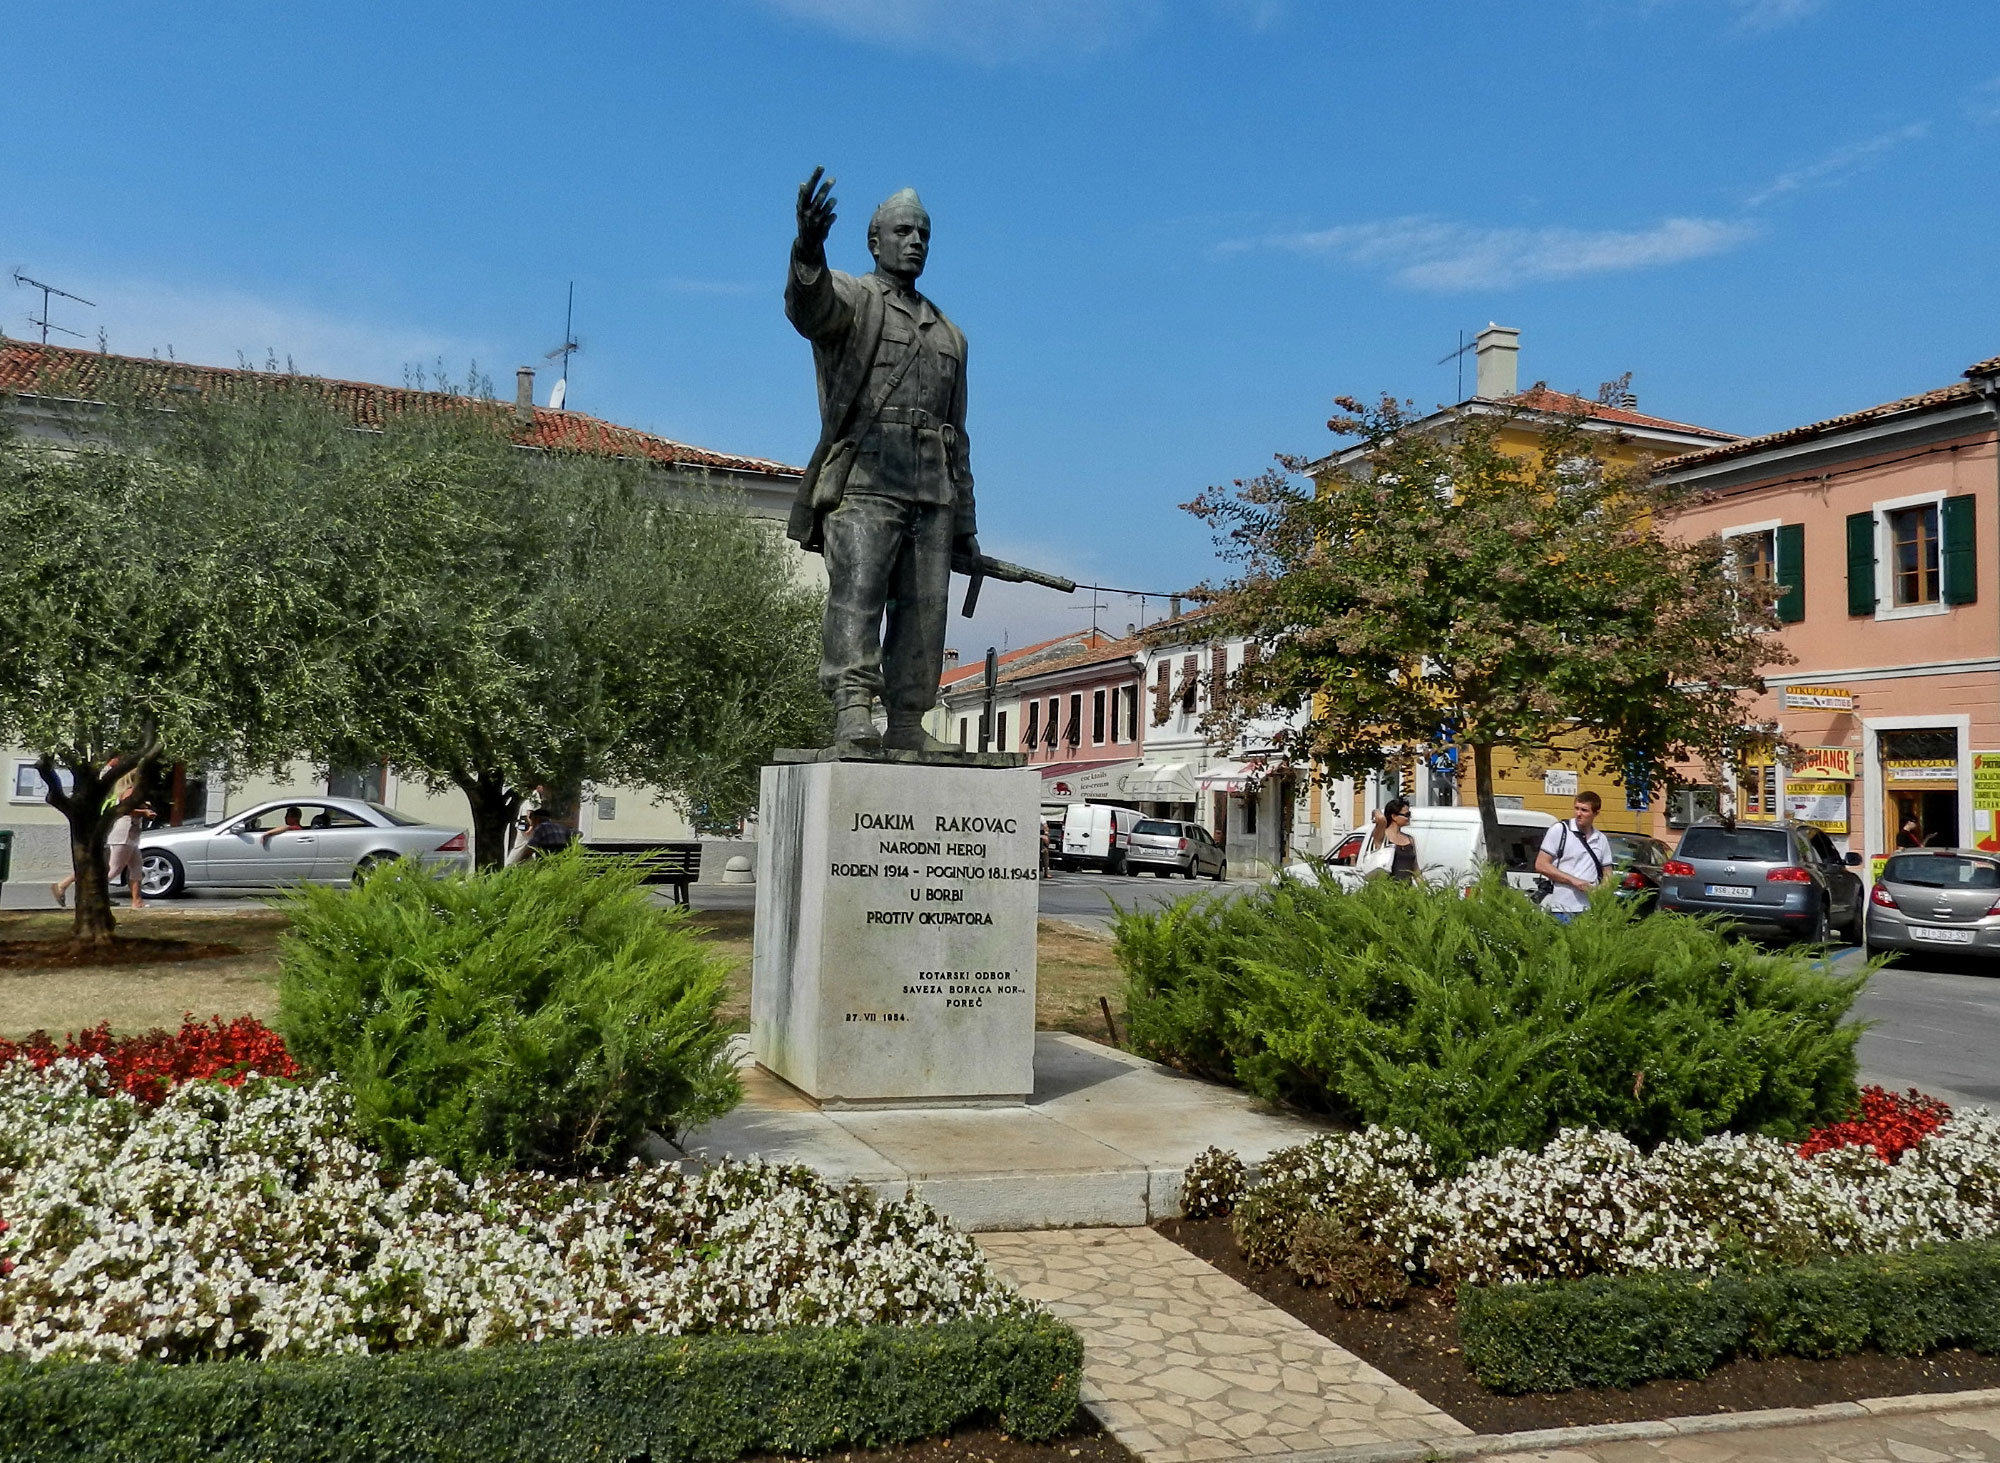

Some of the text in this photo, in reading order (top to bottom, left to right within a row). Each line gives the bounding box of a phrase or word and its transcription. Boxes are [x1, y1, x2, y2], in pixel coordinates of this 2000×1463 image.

[1786, 686, 1850, 697] OTKUP ZLATA
[1794, 749, 1850, 775] CHANGE
[1786, 783, 1844, 791] OTKUP ZLATA
[851, 813, 1017, 834] JOAKIM RAKOVAC
[879, 841, 987, 858] NARODNI HEROJ
[884, 864, 909, 878] 1914
[926, 866, 985, 880] POGINUO
[910, 889, 963, 901] U BORBI
[866, 911, 993, 925] PROTIV OKUPATORA
[919, 971, 1011, 980] KOTARSKI ODBOR
[903, 985, 943, 994] SAVEZA
[949, 985, 992, 994] BORACA
[946, 997, 983, 1008] POREČ
